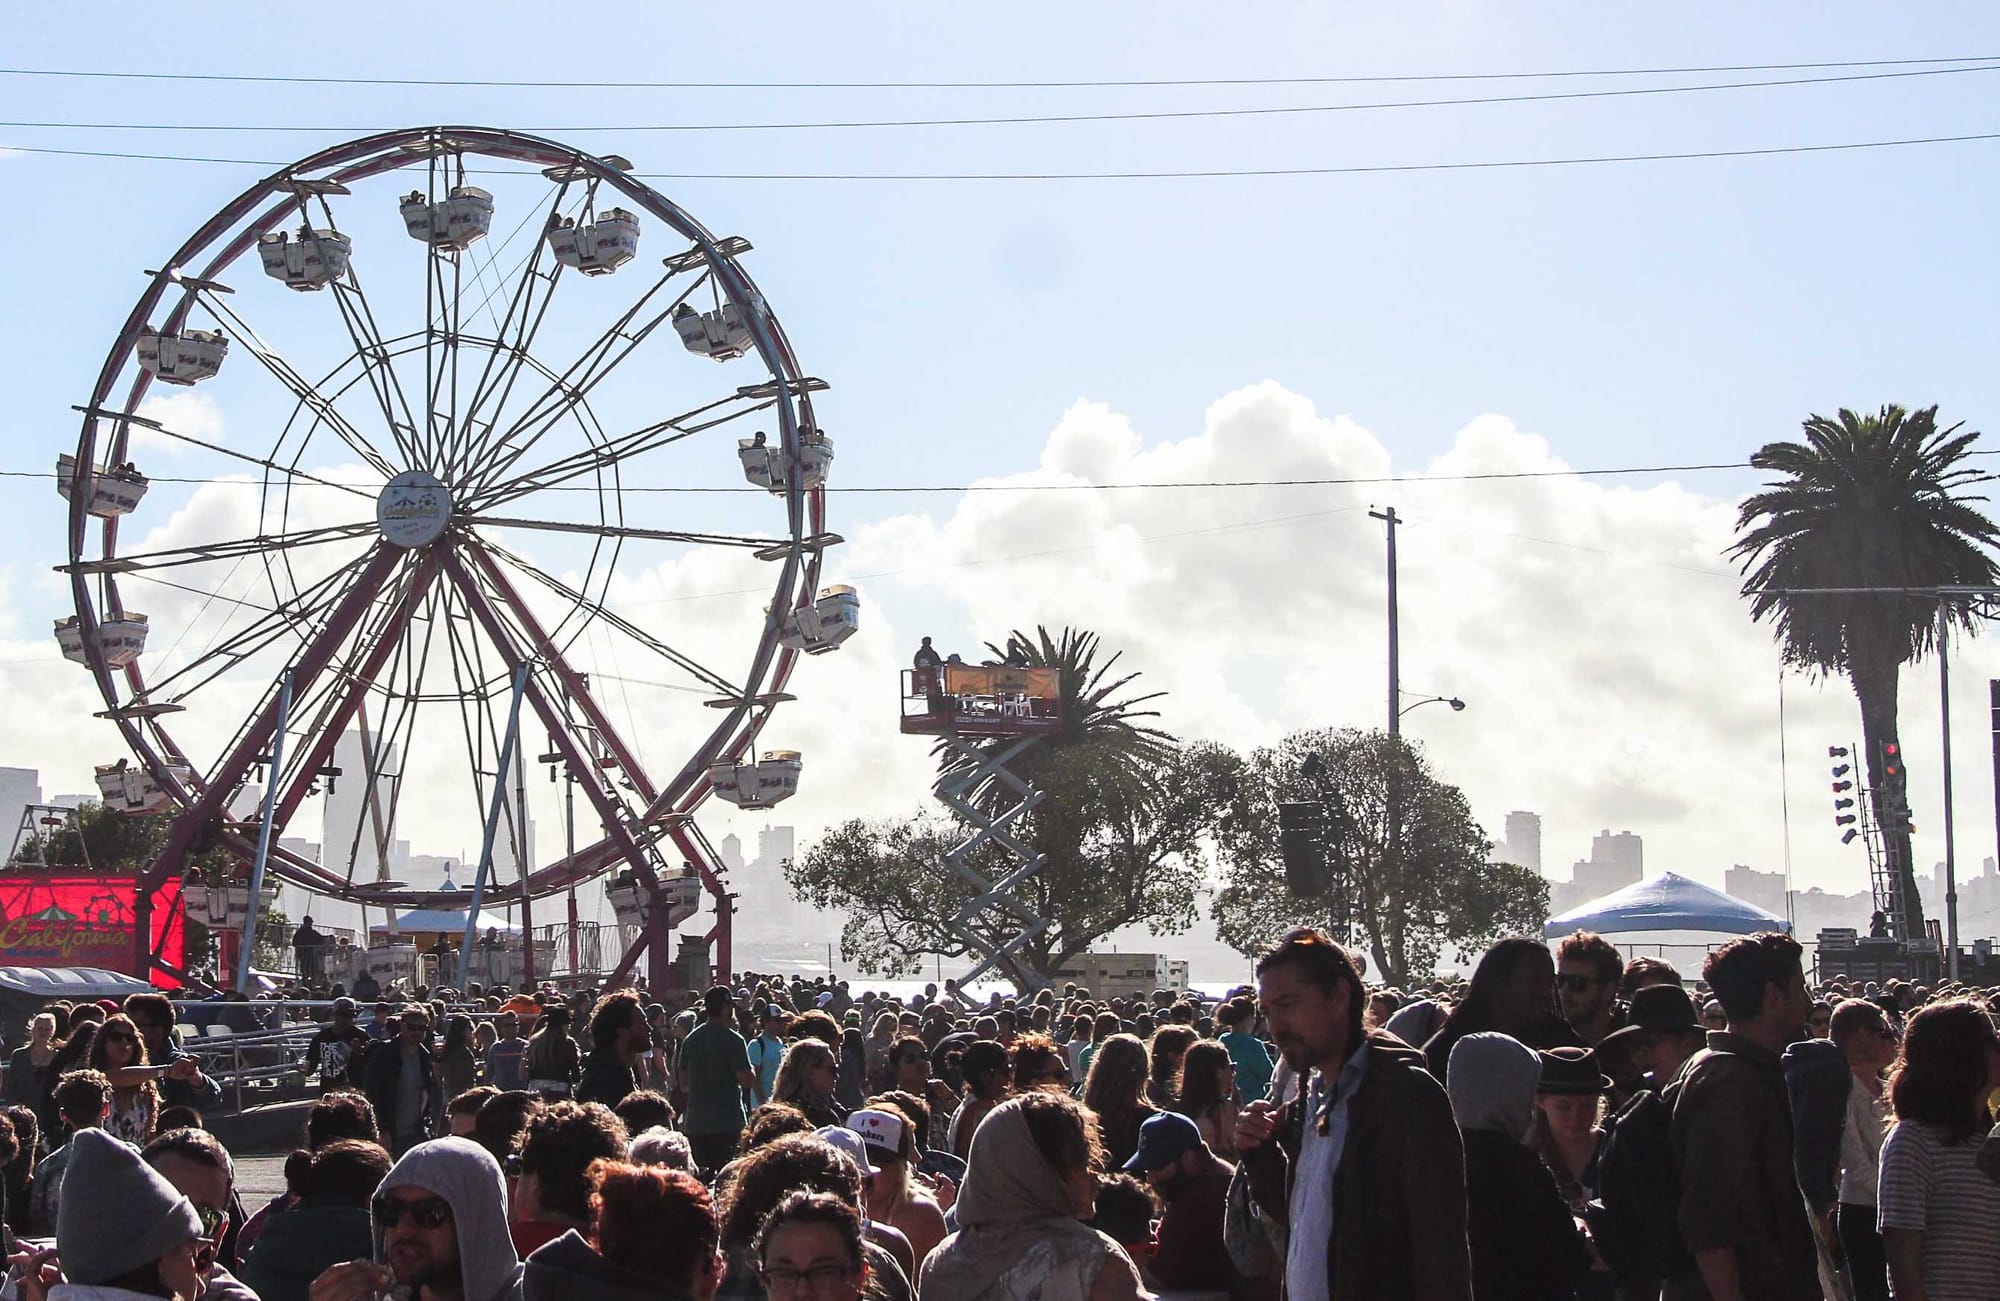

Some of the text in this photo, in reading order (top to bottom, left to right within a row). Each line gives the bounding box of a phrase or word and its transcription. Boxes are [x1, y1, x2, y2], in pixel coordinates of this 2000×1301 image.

[822, 588, 831, 597] 3
[764, 751, 774, 760] 2
[0, 918, 128, 959] California
[320, 1042, 338, 1051] THE
